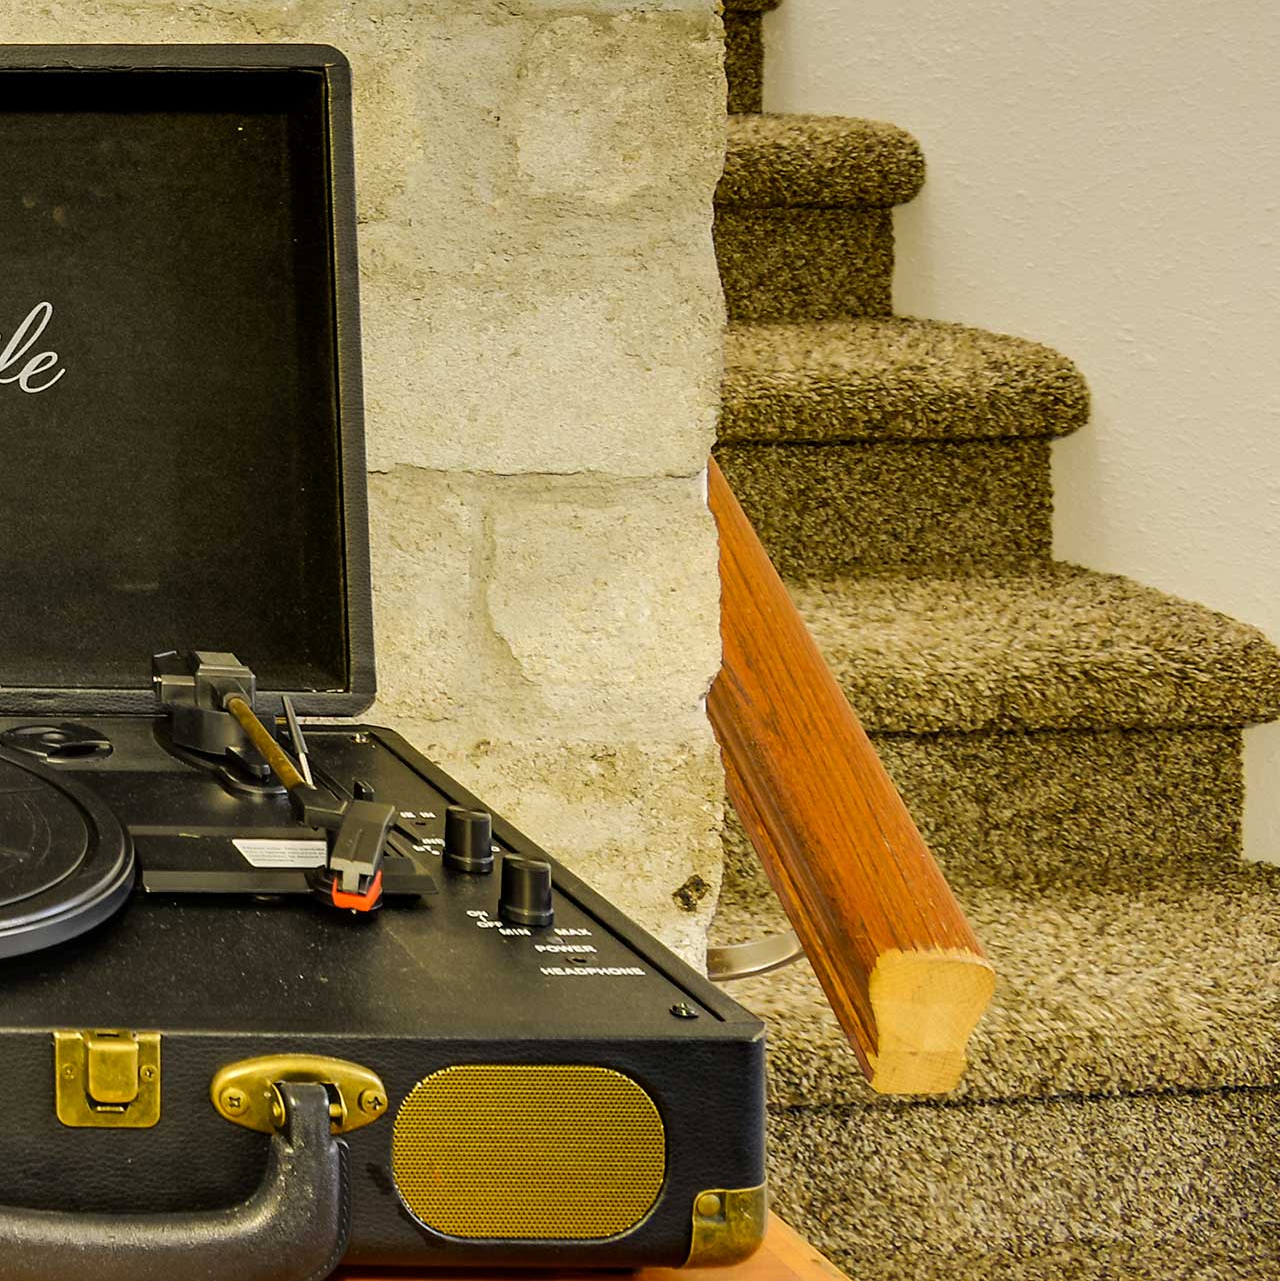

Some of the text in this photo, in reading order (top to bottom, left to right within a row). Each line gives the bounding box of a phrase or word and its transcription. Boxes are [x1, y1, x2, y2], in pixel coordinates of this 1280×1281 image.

[498, 927, 532, 936] MIN
[553, 927, 593, 937] MAX
[535, 944, 598, 954] POWER
[540, 967, 646, 977] HEADPHONE
